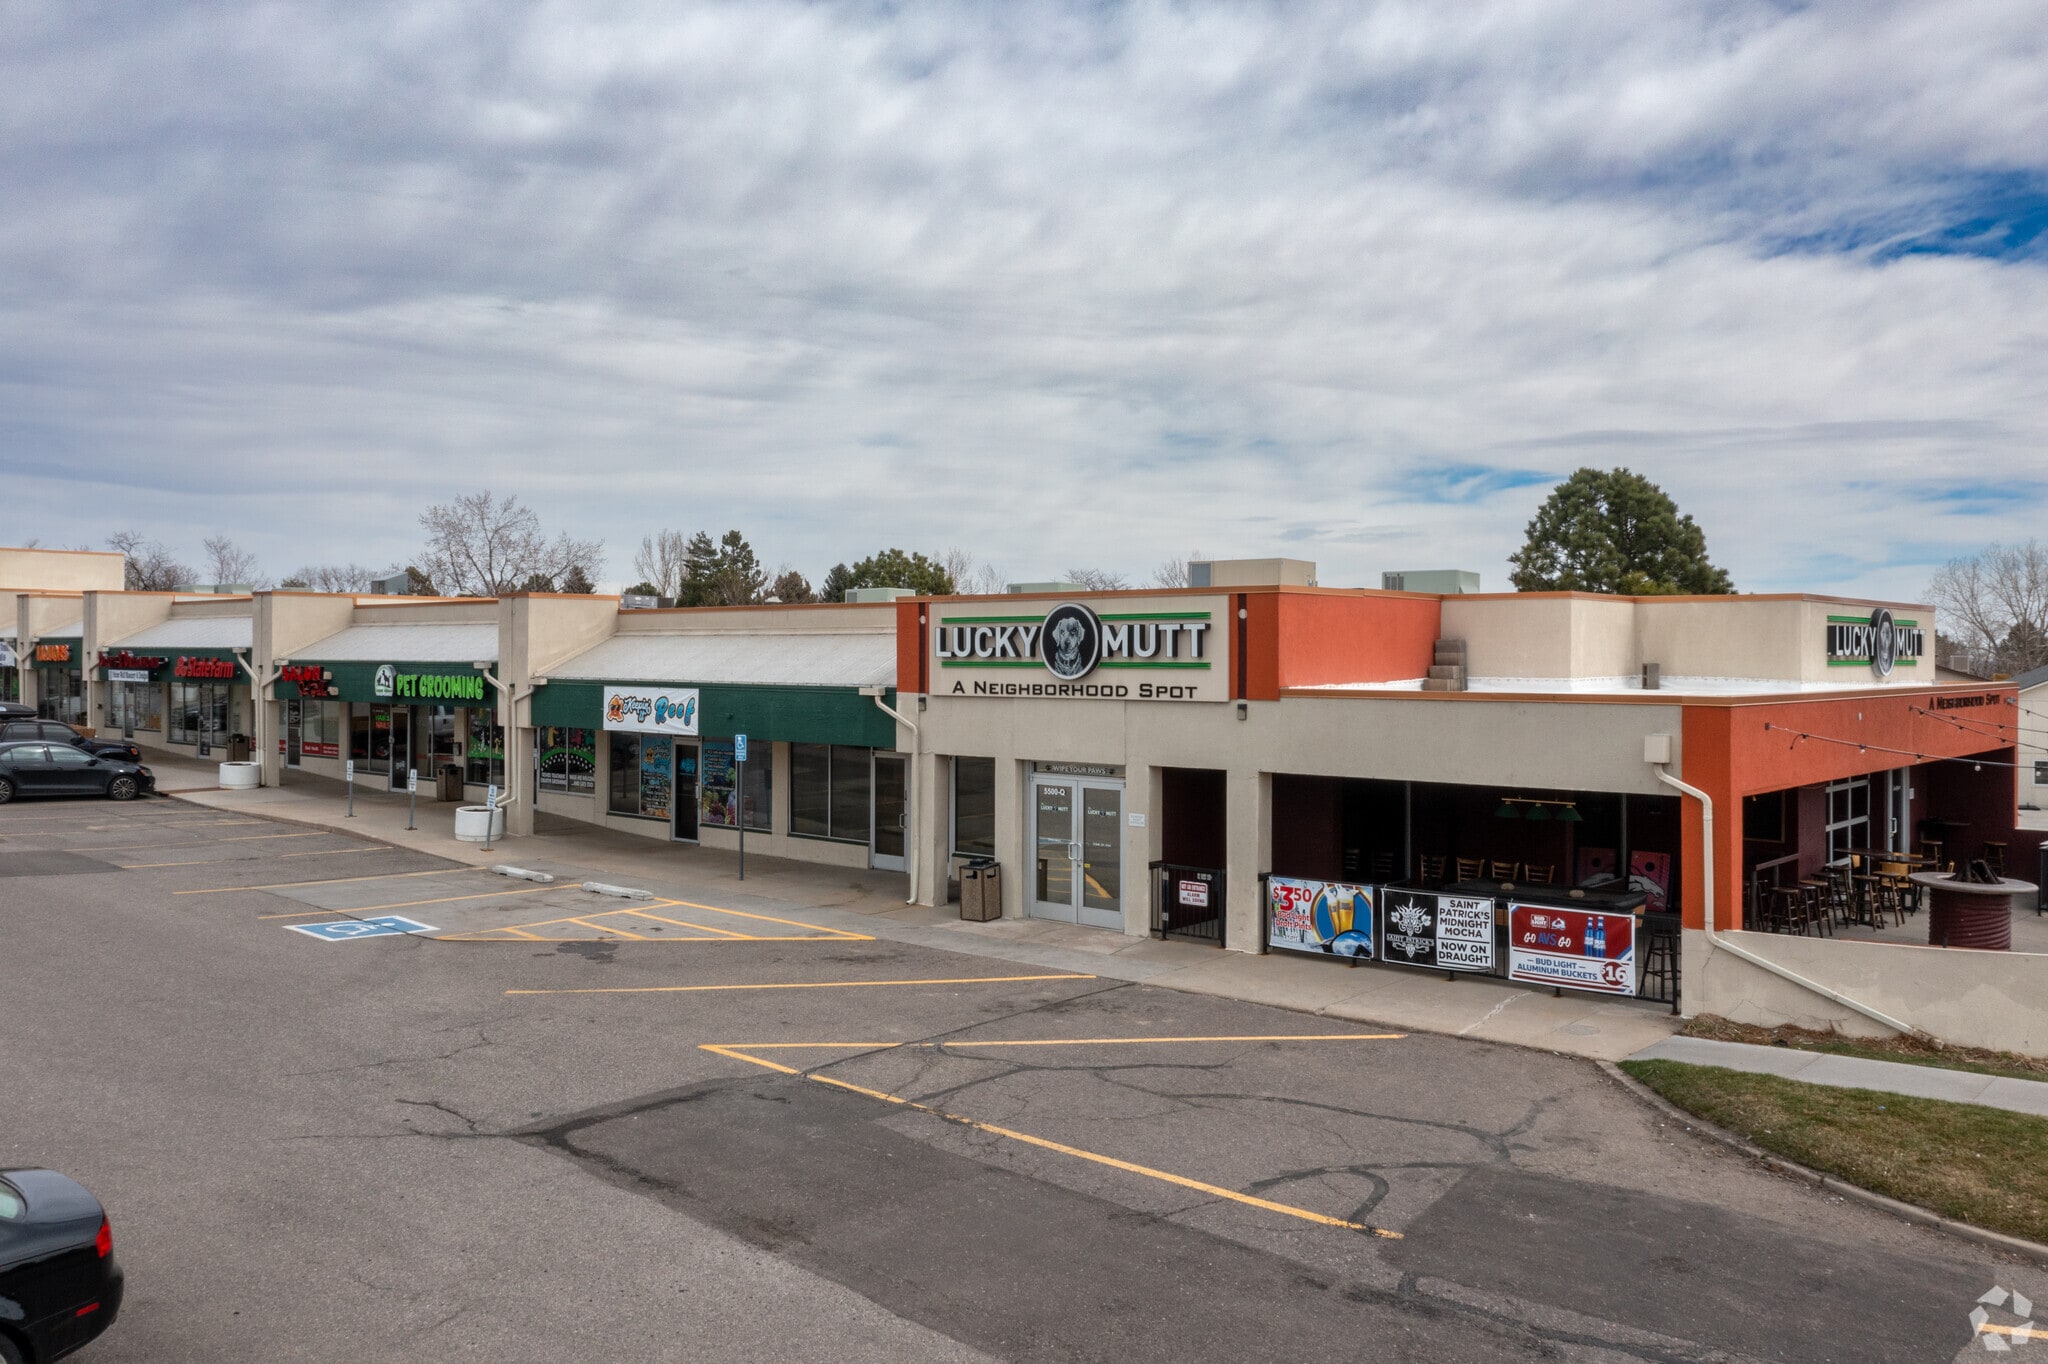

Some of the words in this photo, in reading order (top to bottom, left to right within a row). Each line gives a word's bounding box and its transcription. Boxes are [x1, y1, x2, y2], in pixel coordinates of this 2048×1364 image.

[935, 624, 1041, 659] LUCKY
[1102, 622, 1211, 659] MUTT
[1834, 625, 1877, 657] LUCKY
[1895, 628, 1926, 657] MUTT
[282, 665, 321, 682] SALON
[396, 674, 418, 697] PET
[419, 675, 484, 700] GROOMING
[952, 680, 966, 694] A
[1139, 683, 1199, 699] SPOT
[655, 695, 696, 726] Reef
[1928, 697, 1935, 711] A
[1087, 767, 1106, 775] PAWS
[1043, 787, 1066, 796] 5500-Q
[1449, 900, 1480, 909] SAINT
[1277, 910, 1290, 918] Bud
[1291, 912, 1310, 921] Light
[1439, 908, 1491, 920] PATRICK'S
[1275, 919, 1292, 928] Draft
[1294, 921, 1312, 930] Pints
[1439, 917, 1489, 929] MIDNIGHT
[1445, 926, 1483, 938] MOCHA
[1386, 933, 1405, 942] SAINT
[1406, 935, 1435, 946] PATRICK'S
[1523, 933, 1536, 943] GO
[1538, 932, 1556, 946] AVS
[1558, 937, 1571, 947] GO
[1441, 941, 1467, 952] NOW
[1470, 943, 1487, 954] ON
[1438, 951, 1490, 964] DRAUGHT
[1535, 957, 1553, 966] BUD
[1553, 958, 1578, 969] LIGHT
[1517, 962, 1560, 976] ALUMINUM
[1560, 967, 1598, 981] BUCKETS
[1600, 965, 1629, 983] $16
